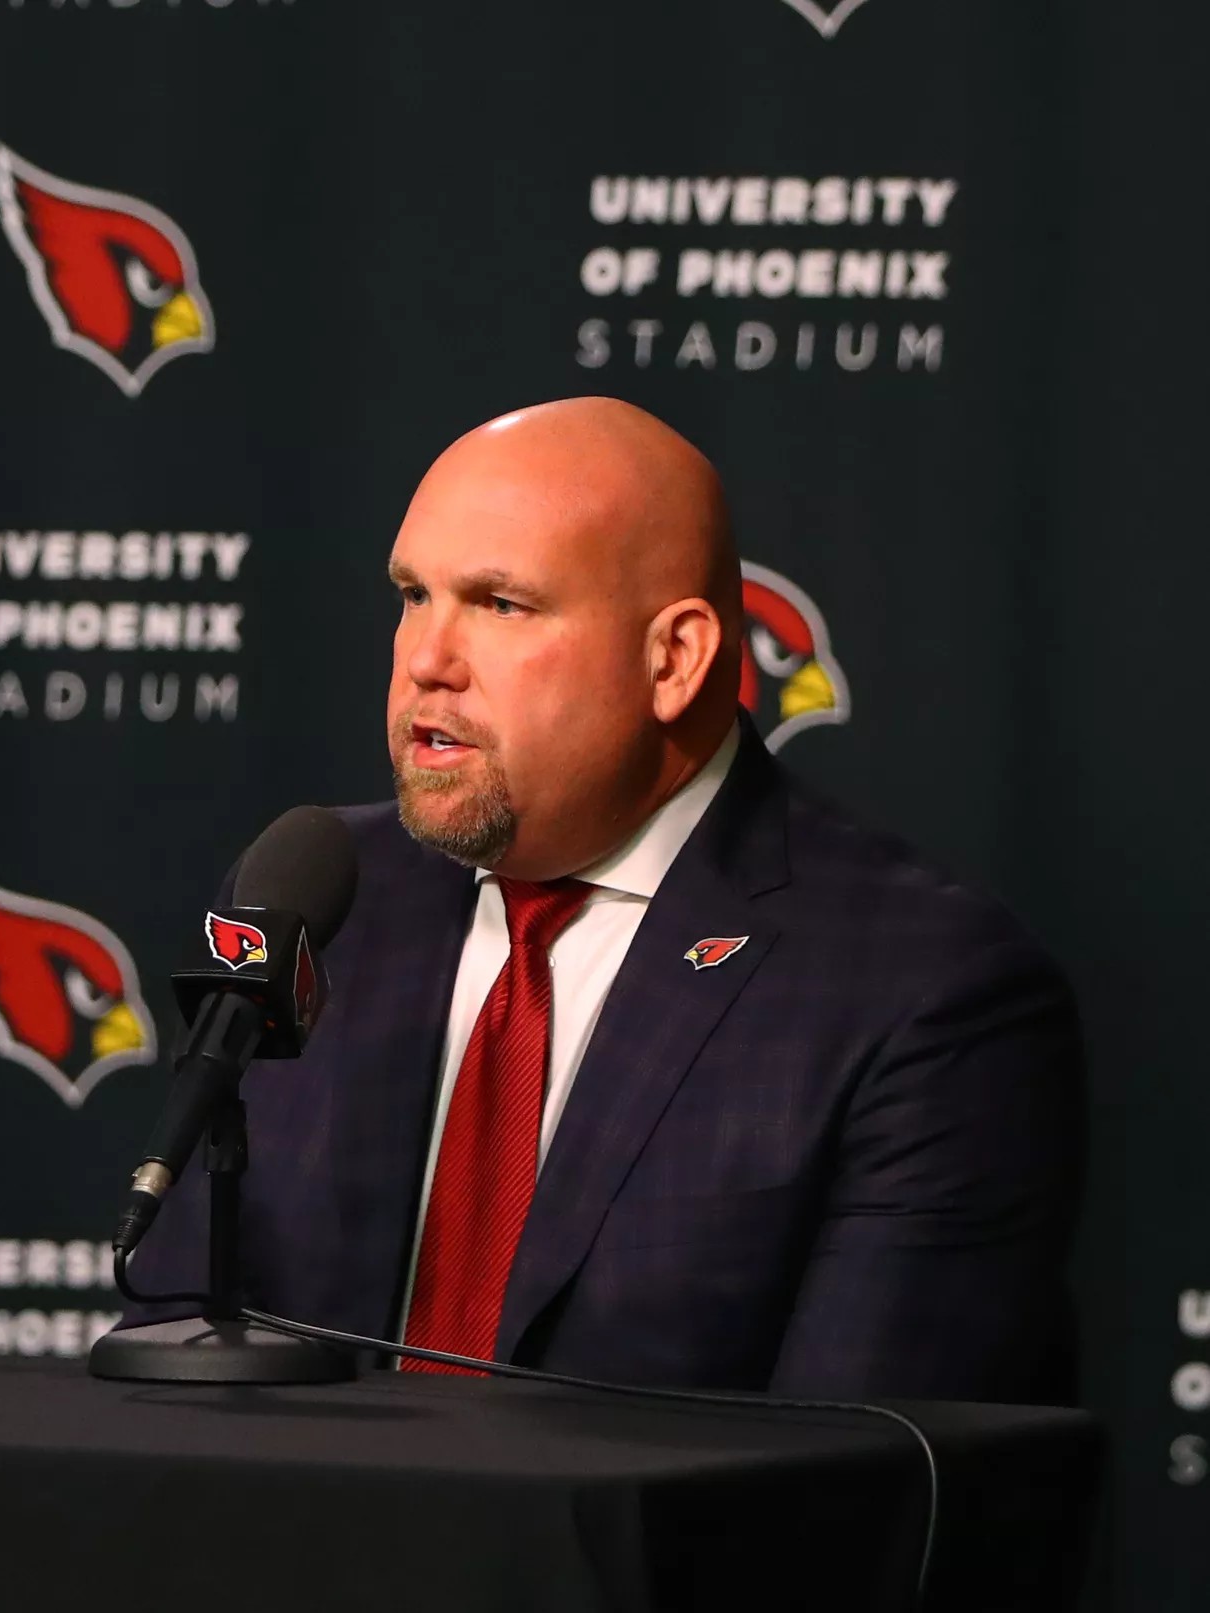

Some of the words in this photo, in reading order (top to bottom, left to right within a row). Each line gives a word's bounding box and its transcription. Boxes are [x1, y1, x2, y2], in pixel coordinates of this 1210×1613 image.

[590, 175, 958, 226] UNIVERSITY
[580, 246, 660, 296] OF
[676, 248, 949, 298] PHOENIX
[575, 318, 943, 372] STADIUM
